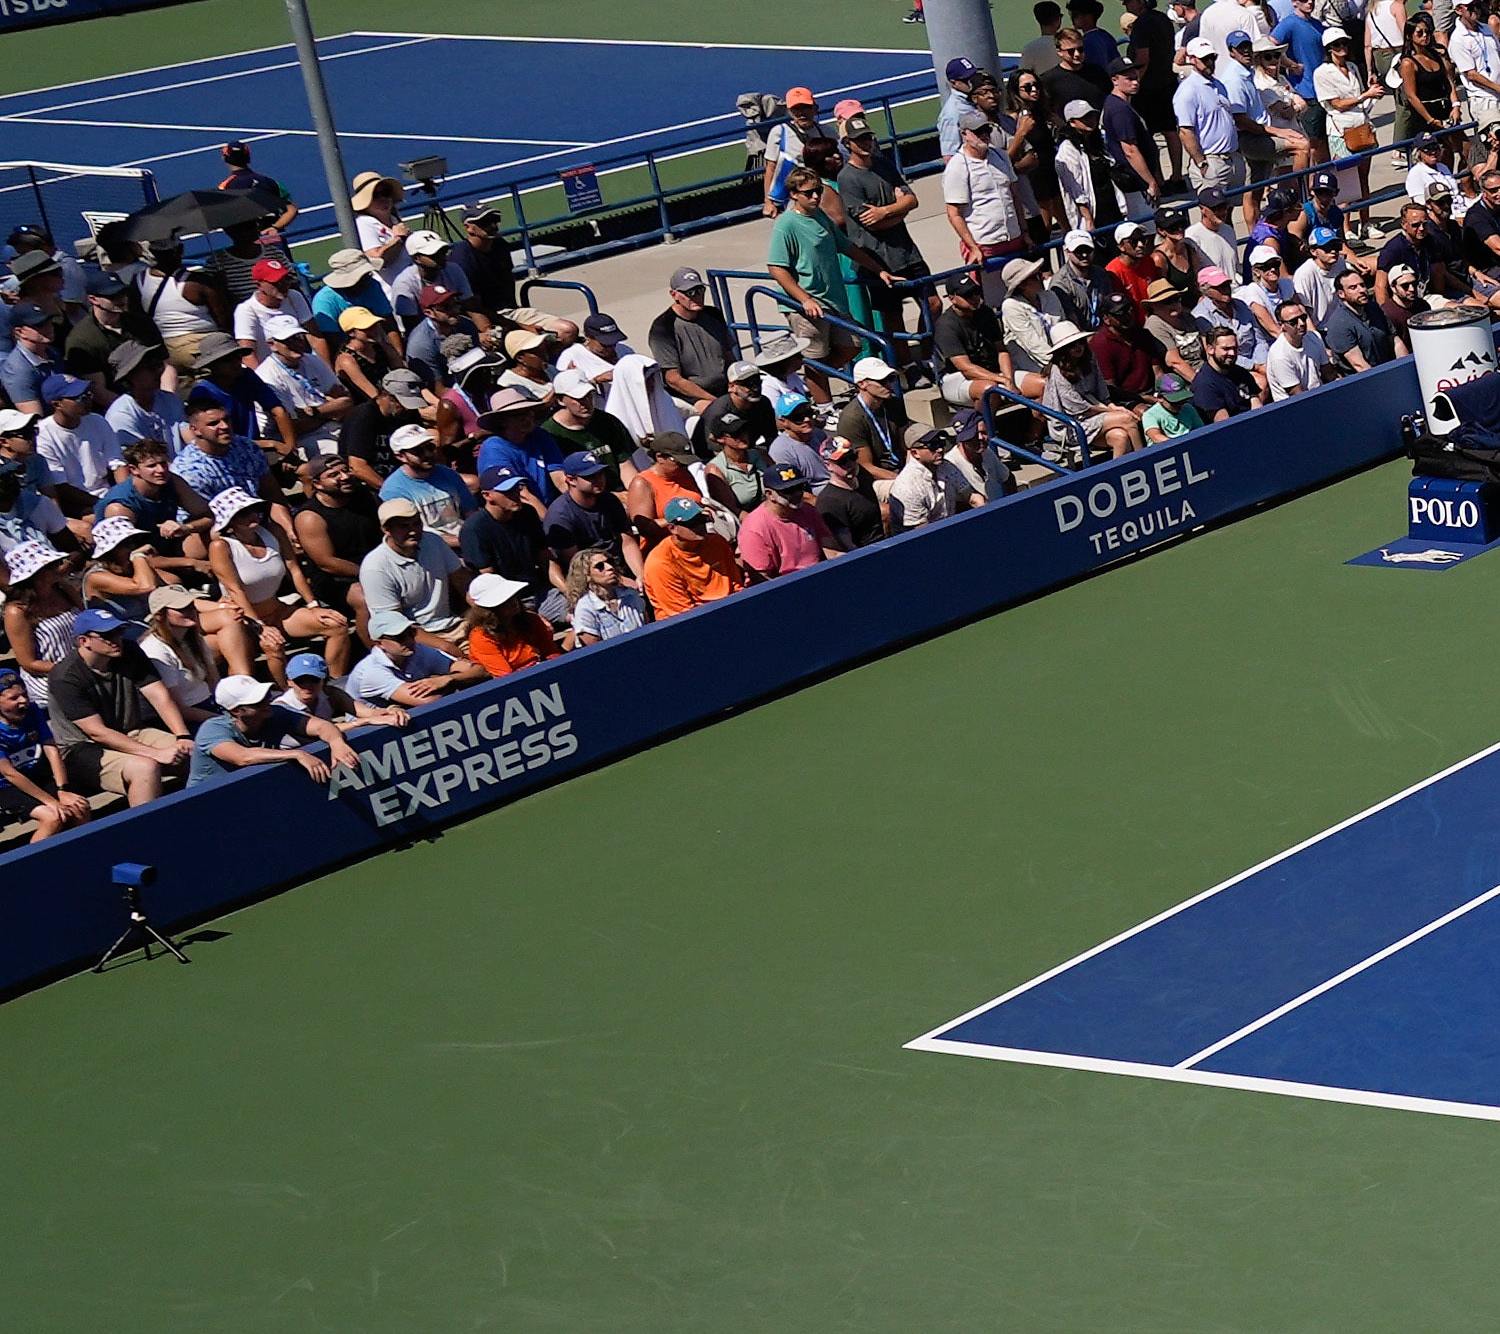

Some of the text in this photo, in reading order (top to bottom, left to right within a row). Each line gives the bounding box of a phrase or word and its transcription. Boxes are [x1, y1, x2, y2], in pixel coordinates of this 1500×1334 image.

[1053, 452, 1208, 532] DOBEL
[1089, 500, 1196, 555] TEQUILA
[1411, 497, 1479, 529] POLO
[327, 682, 565, 801] AMERICAN
[371, 721, 578, 826] EXPRESS
